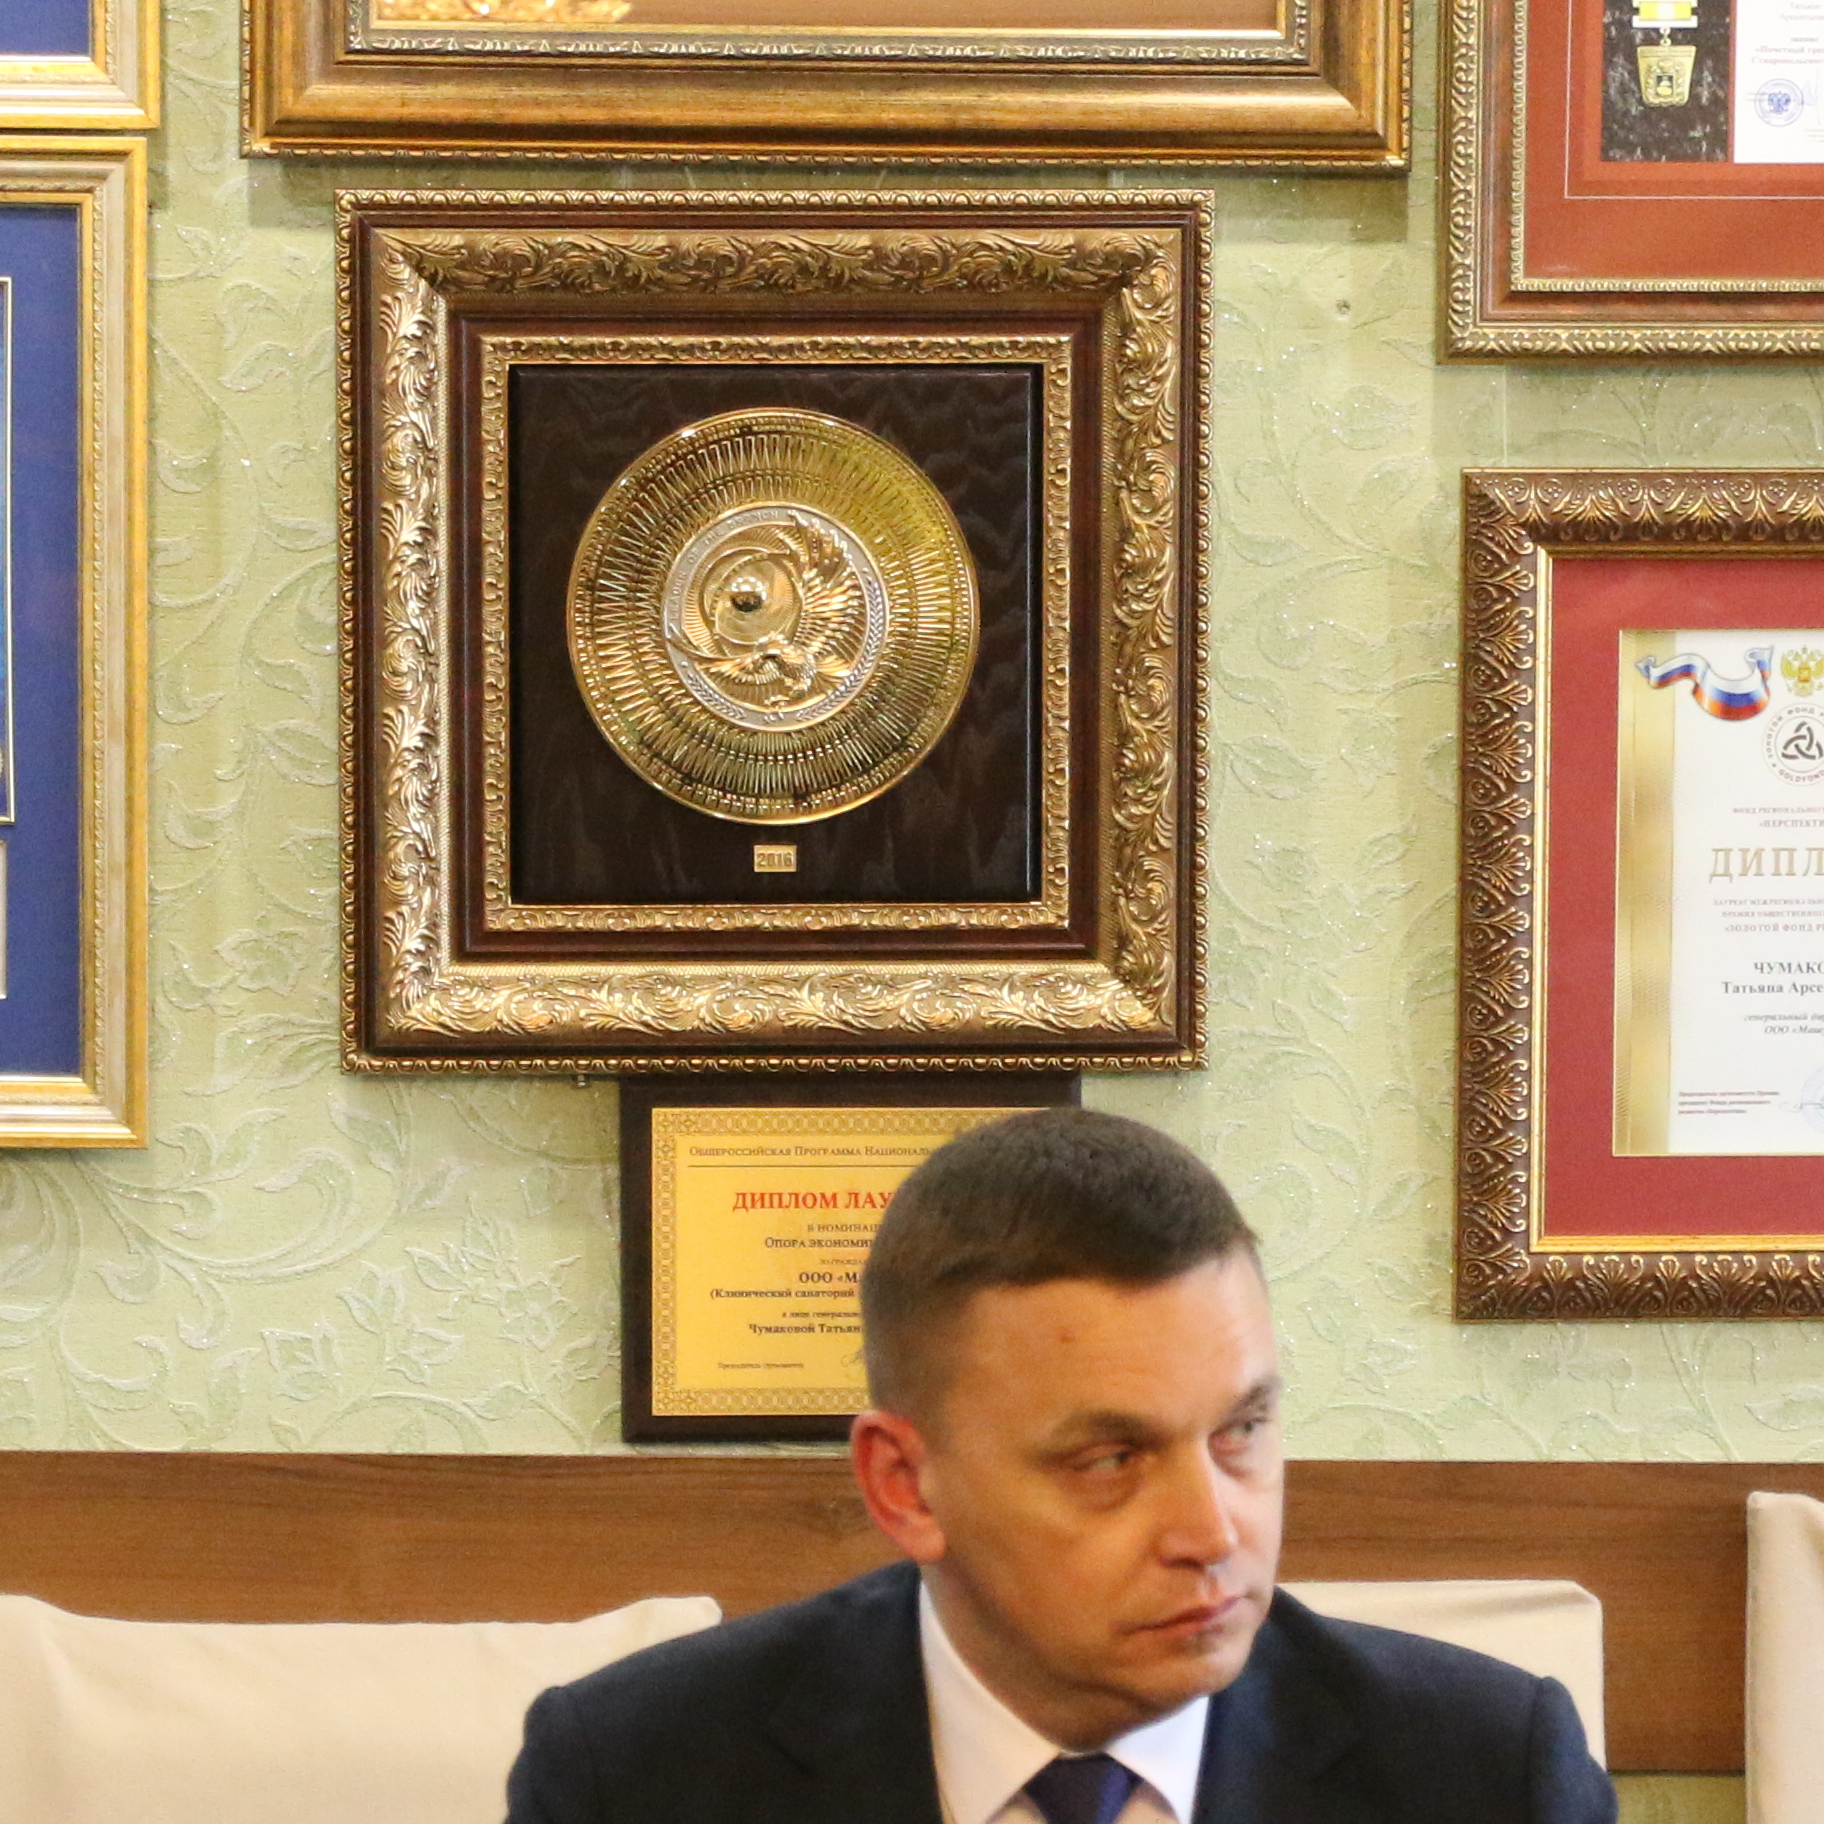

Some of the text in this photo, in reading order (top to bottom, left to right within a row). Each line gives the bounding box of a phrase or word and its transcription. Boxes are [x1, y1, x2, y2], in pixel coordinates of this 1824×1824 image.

[1786, 706, 1816, 717] ФОНД
[756, 851, 793, 867] 2016
[1782, 923, 1814, 933] ФОНД
[1720, 980, 1784, 995] Татьяна
[1763, 1025, 1790, 1035] ООО
[865, 1145, 933, 1157] НАЦИОНАЛЬ
[732, 1191, 896, 1212] ДИПЛОМ ЛАУ
[798, 1271, 833, 1284] ООО
[794, 1287, 855, 1300] санаторий
[749, 1322, 862, 1336] Чумаковой Татьян
